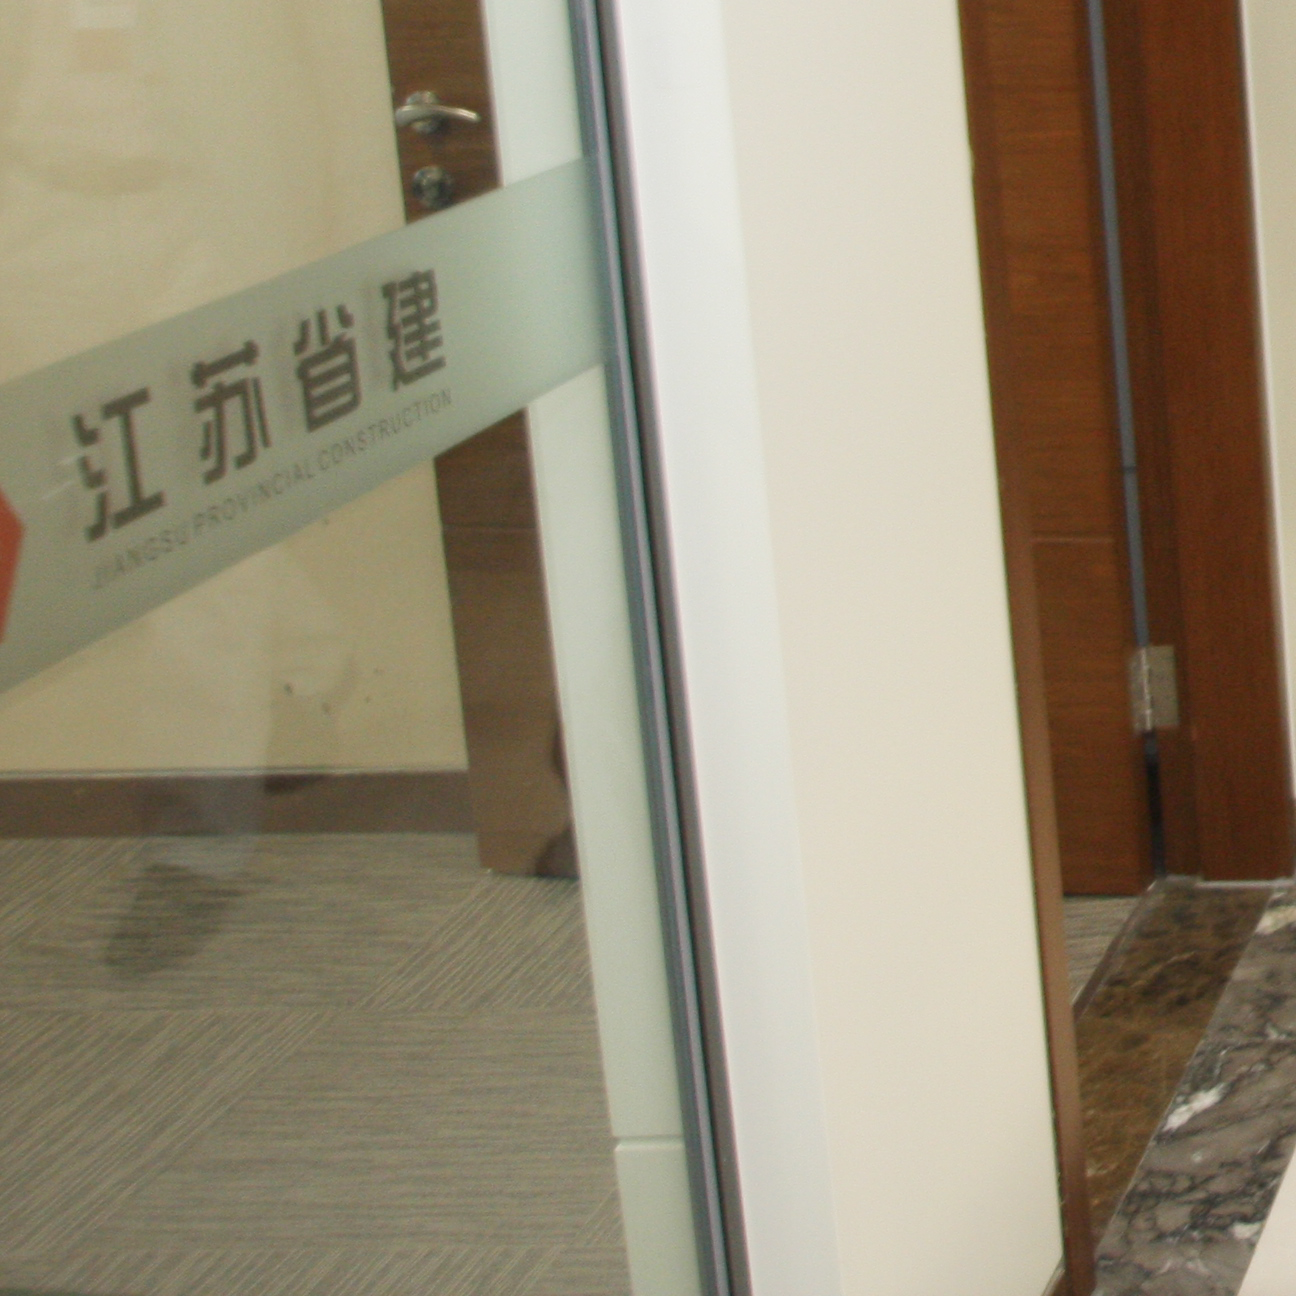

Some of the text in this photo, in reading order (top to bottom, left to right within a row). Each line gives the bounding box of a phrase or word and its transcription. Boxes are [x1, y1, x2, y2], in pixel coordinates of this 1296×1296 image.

[72, 268, 447, 543] 江苏省建
[194, 455, 316, 533] PROVINCIAL
[316, 388, 453, 472] CONSTRUCTION
